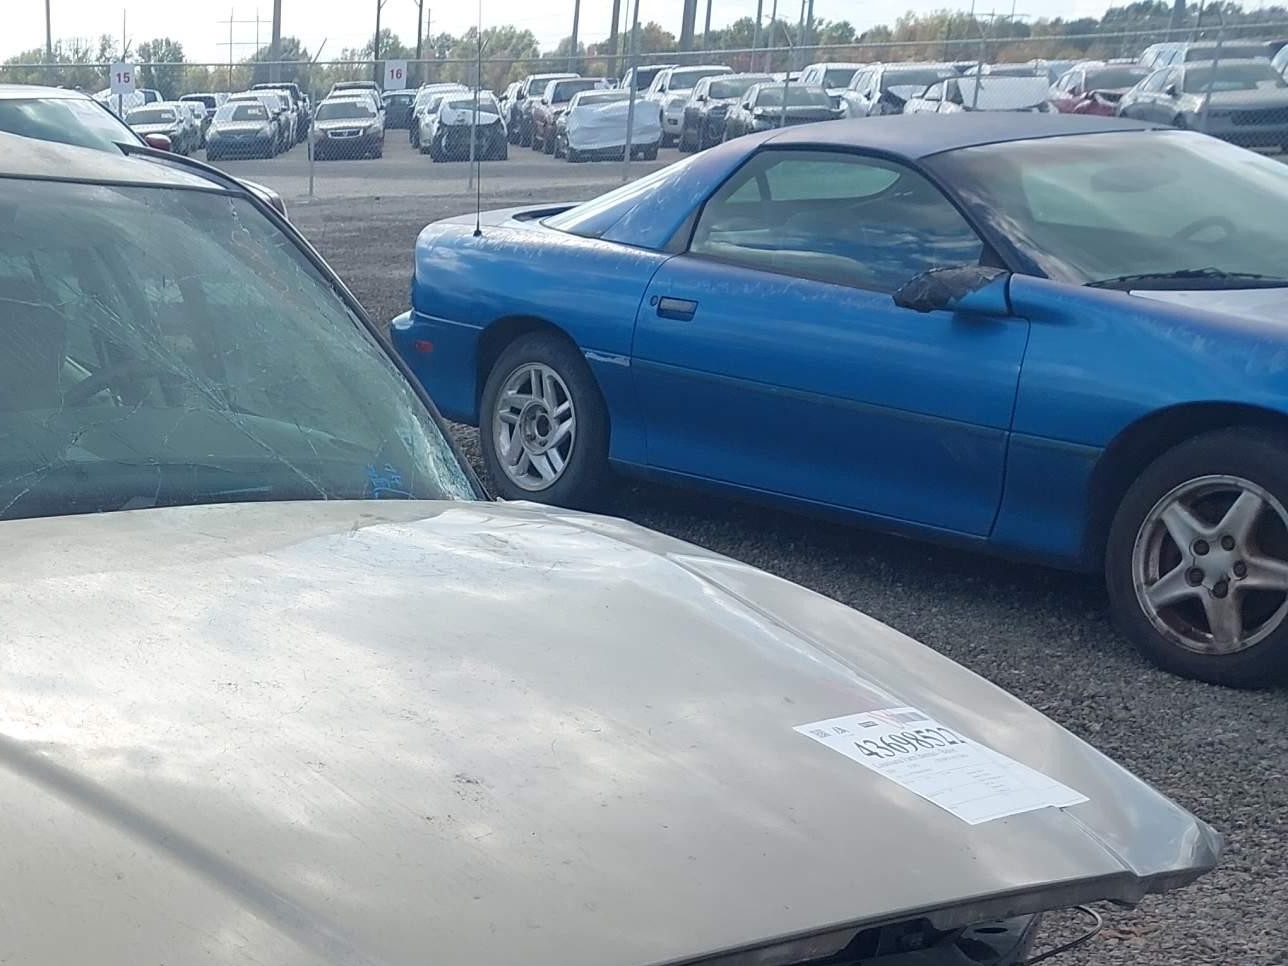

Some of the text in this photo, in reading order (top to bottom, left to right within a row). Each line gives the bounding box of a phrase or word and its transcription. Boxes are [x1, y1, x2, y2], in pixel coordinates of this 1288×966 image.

[115, 72, 130, 83] 15
[389, 68, 402, 80] 16
[853, 727, 968, 759] 43698522
